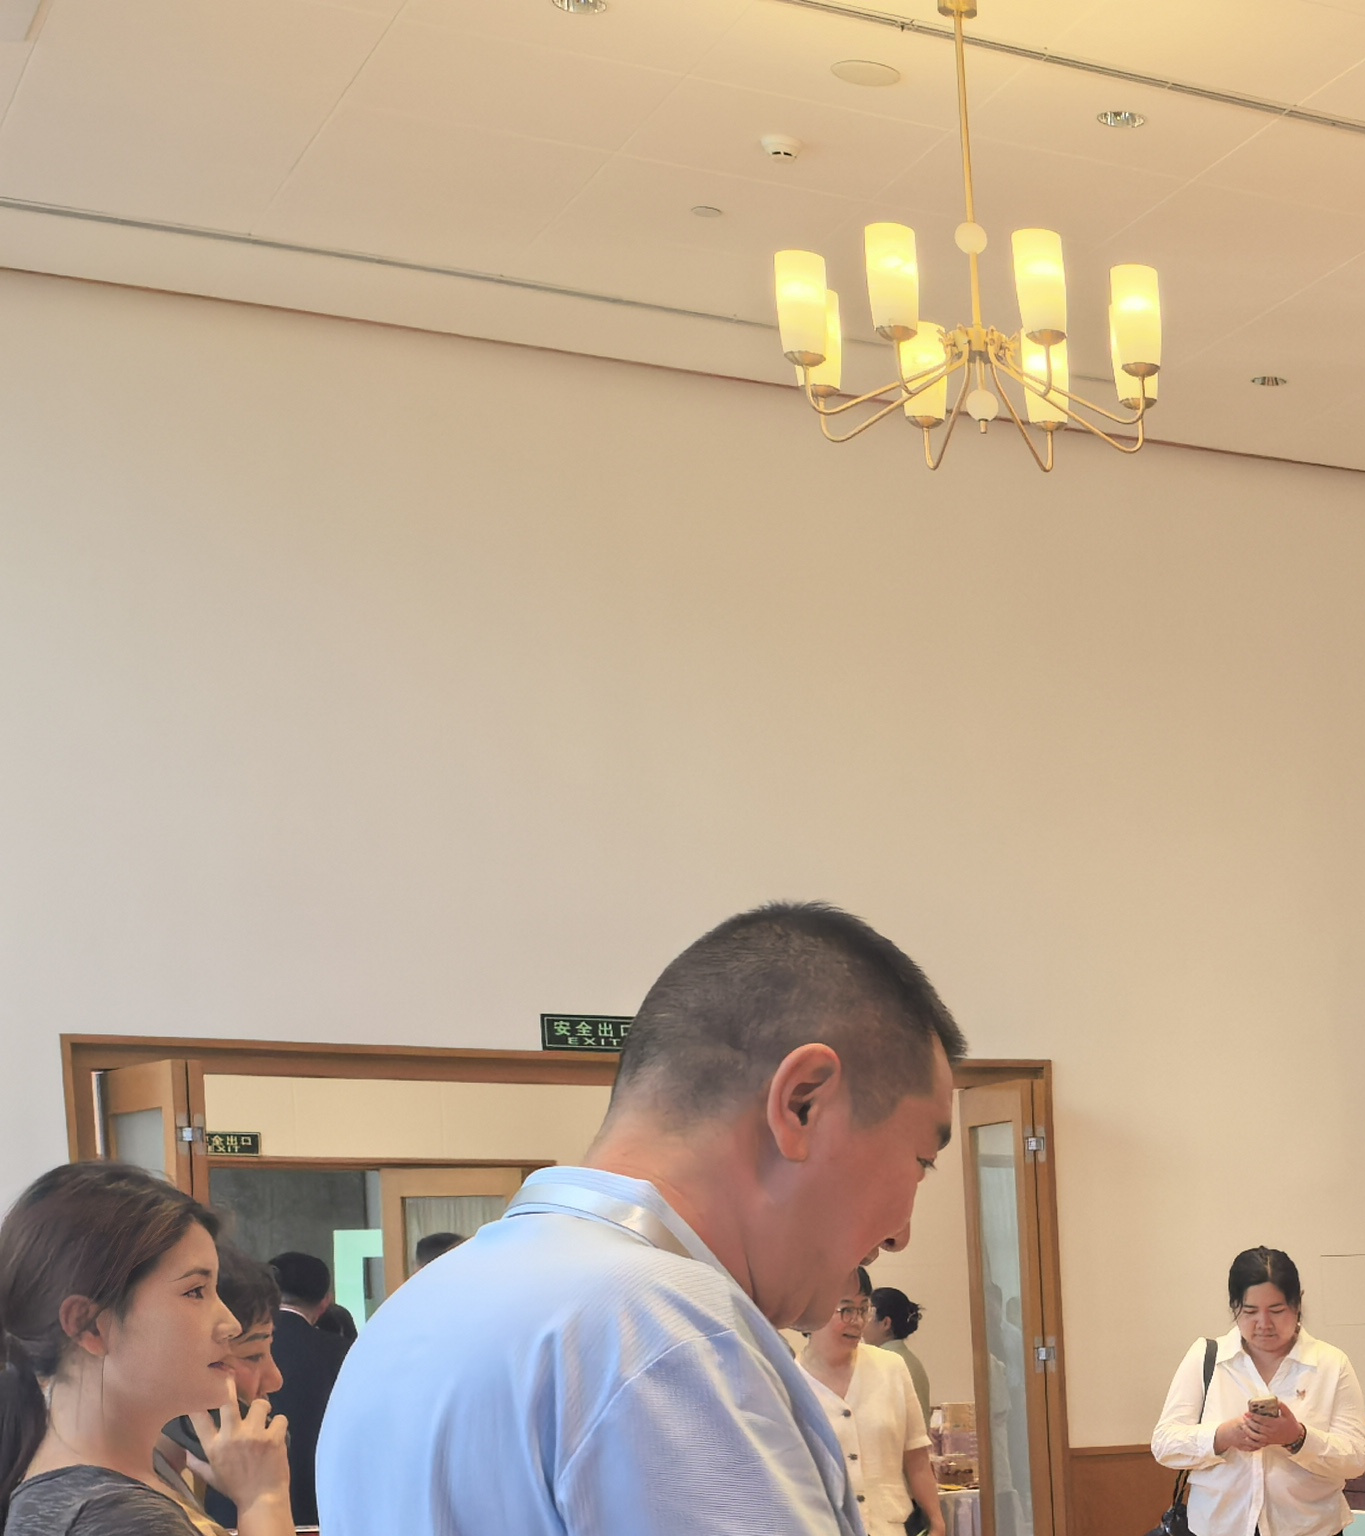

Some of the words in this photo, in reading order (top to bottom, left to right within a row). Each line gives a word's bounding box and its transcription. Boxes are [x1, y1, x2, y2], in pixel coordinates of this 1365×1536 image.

[567, 1037, 621, 1046] EXIT
[206, 1135, 252, 1146] 全出口
